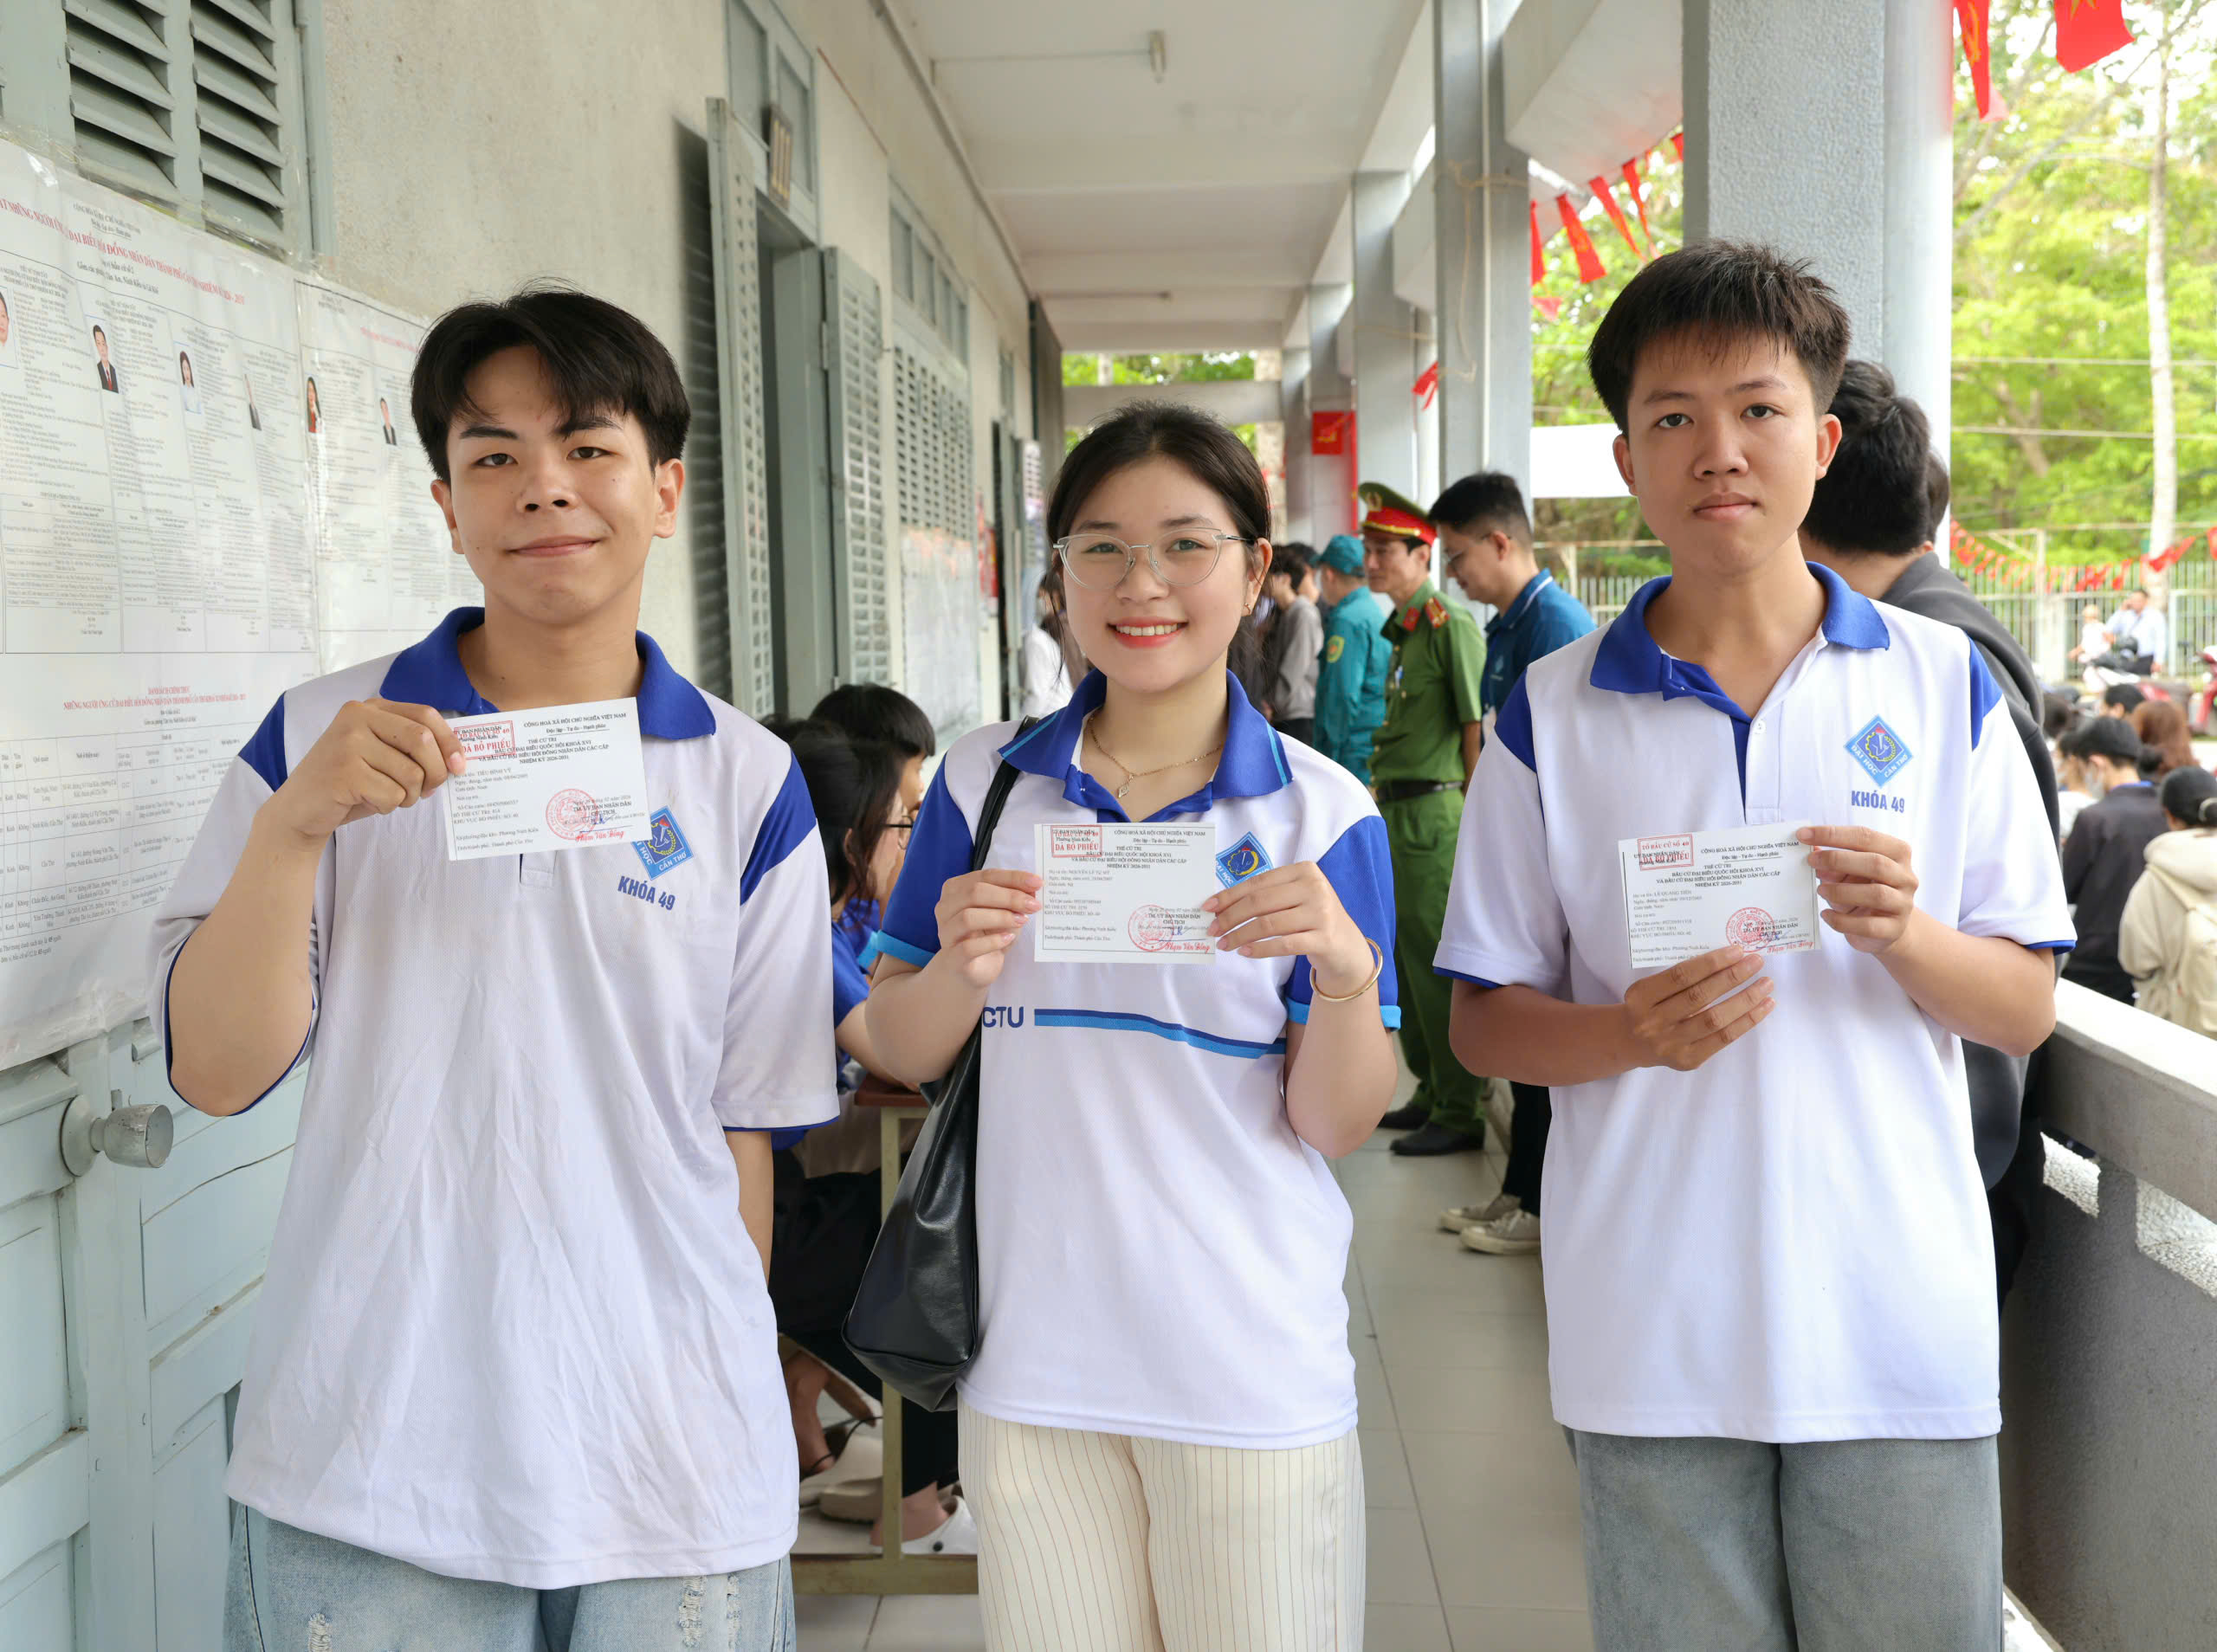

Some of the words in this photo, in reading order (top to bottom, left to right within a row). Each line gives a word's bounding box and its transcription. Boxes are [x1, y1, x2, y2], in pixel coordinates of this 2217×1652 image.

[1851, 790, 1887, 810] KHÓA
[1891, 797, 1905, 813] 49
[617, 875, 656, 904] KHÓA
[658, 892, 675, 910] 49
[982, 1006, 1024, 1029] CTU
